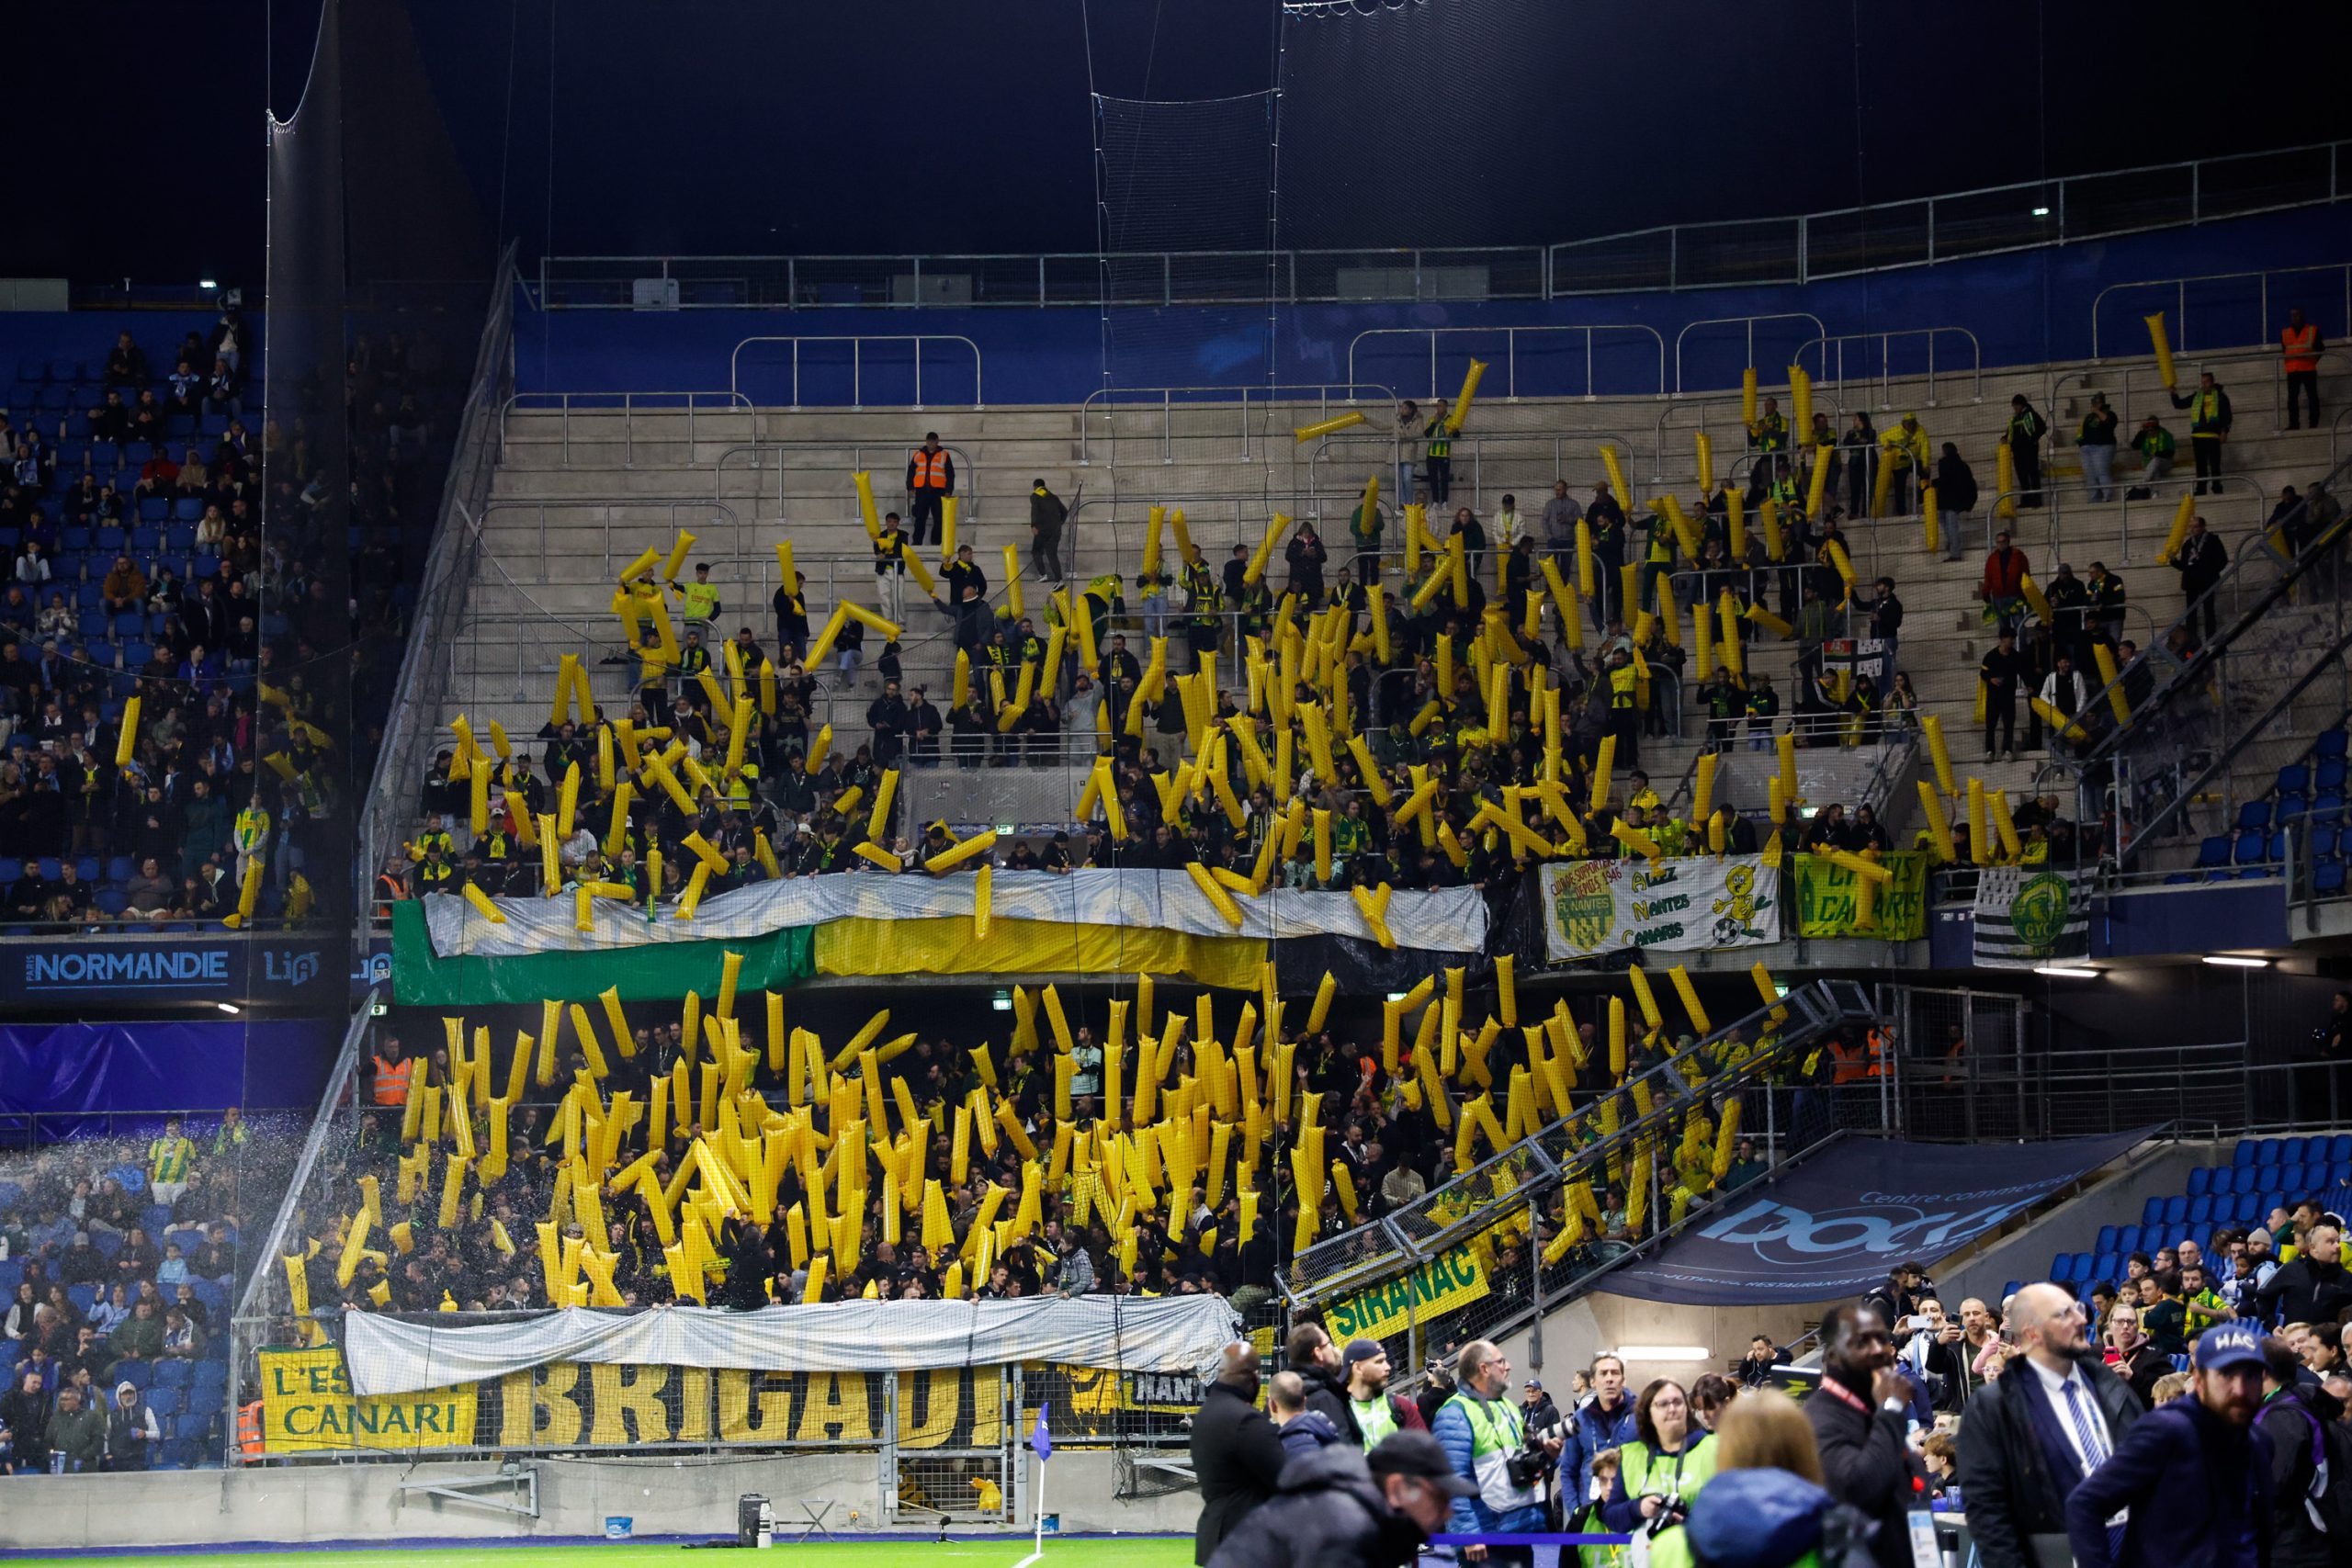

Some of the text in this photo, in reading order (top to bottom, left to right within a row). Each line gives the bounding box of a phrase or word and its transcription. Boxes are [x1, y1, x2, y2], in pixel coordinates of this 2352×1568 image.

[1602, 867, 1623, 885] 1946
[1571, 897, 1610, 912] NANTES
[1633, 894, 1690, 922] NANTES
[1622, 922, 1685, 948] CANARIS
[26, 954, 35, 982] PARIS
[35, 951, 229, 981] NORMANDIE
[1860, 1168, 2086, 1204] Centre commercial
[2215, 1332, 2256, 1352] HAC
[283, 1403, 457, 1435] CANARI
